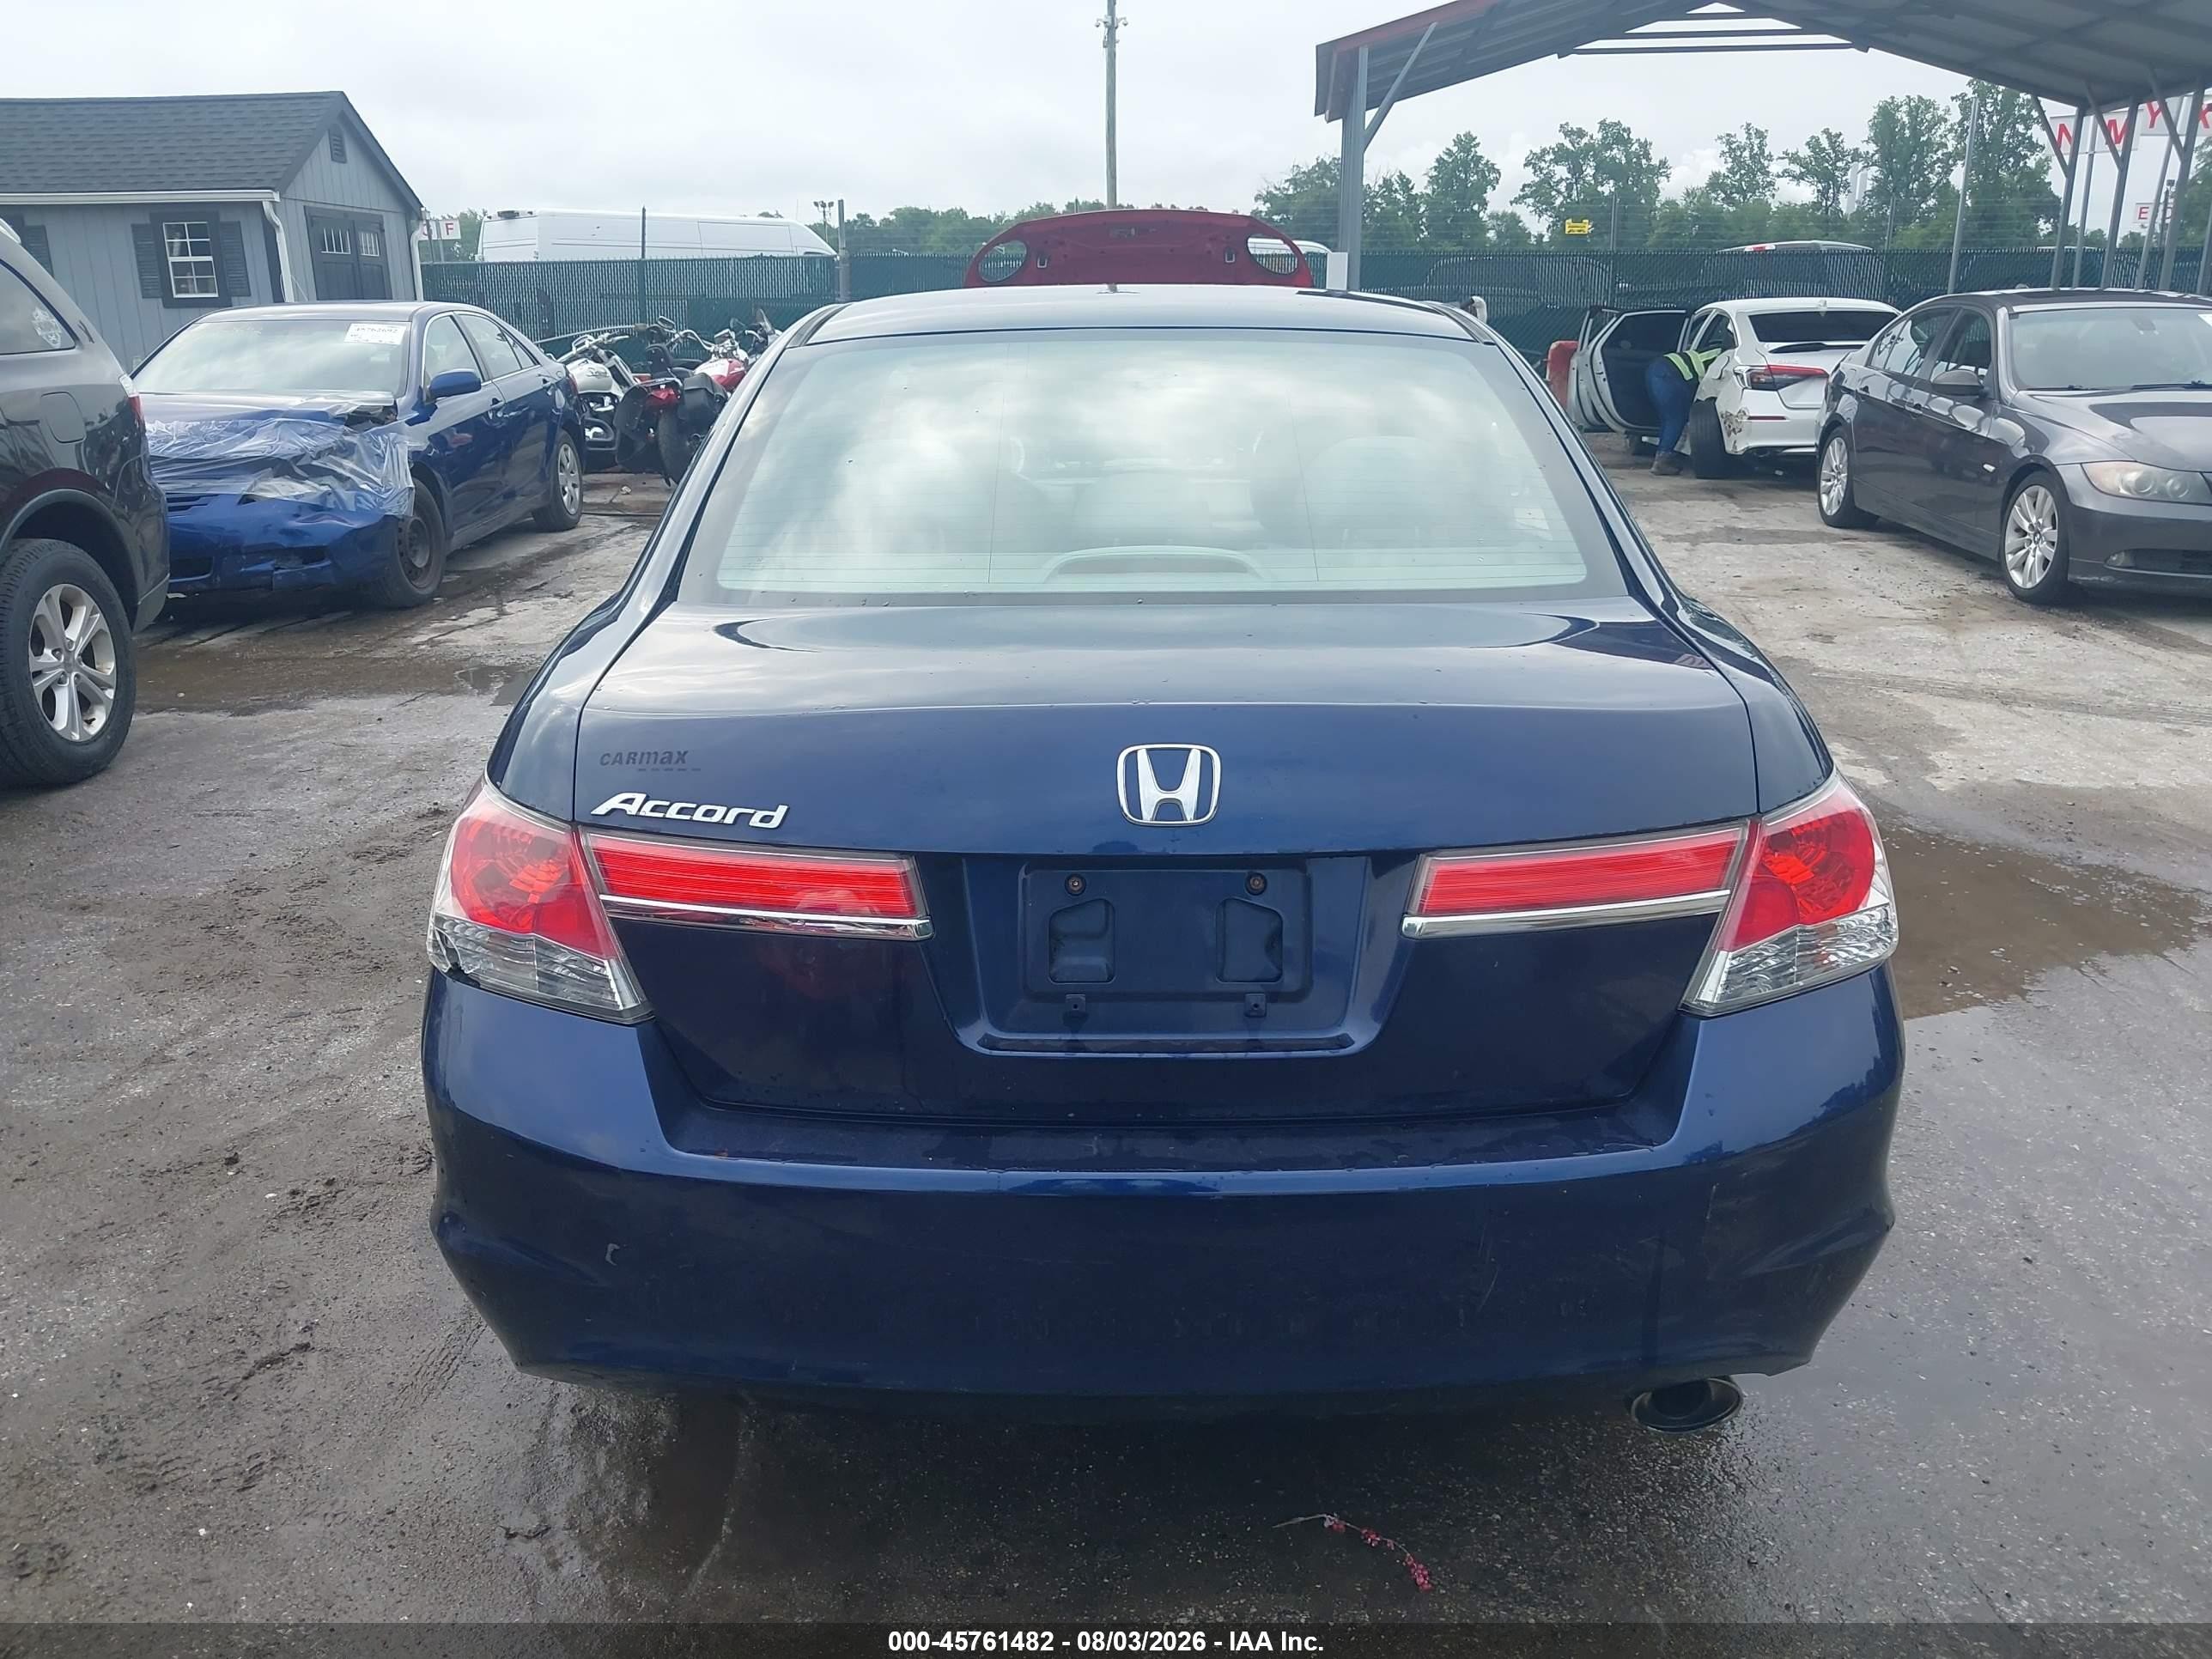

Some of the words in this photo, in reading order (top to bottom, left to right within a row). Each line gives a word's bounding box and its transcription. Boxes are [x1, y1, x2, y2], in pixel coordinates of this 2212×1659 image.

[2138, 207, 2149, 220] E
[445, 222, 454, 235] F
[590, 792, 789, 830] Accord
